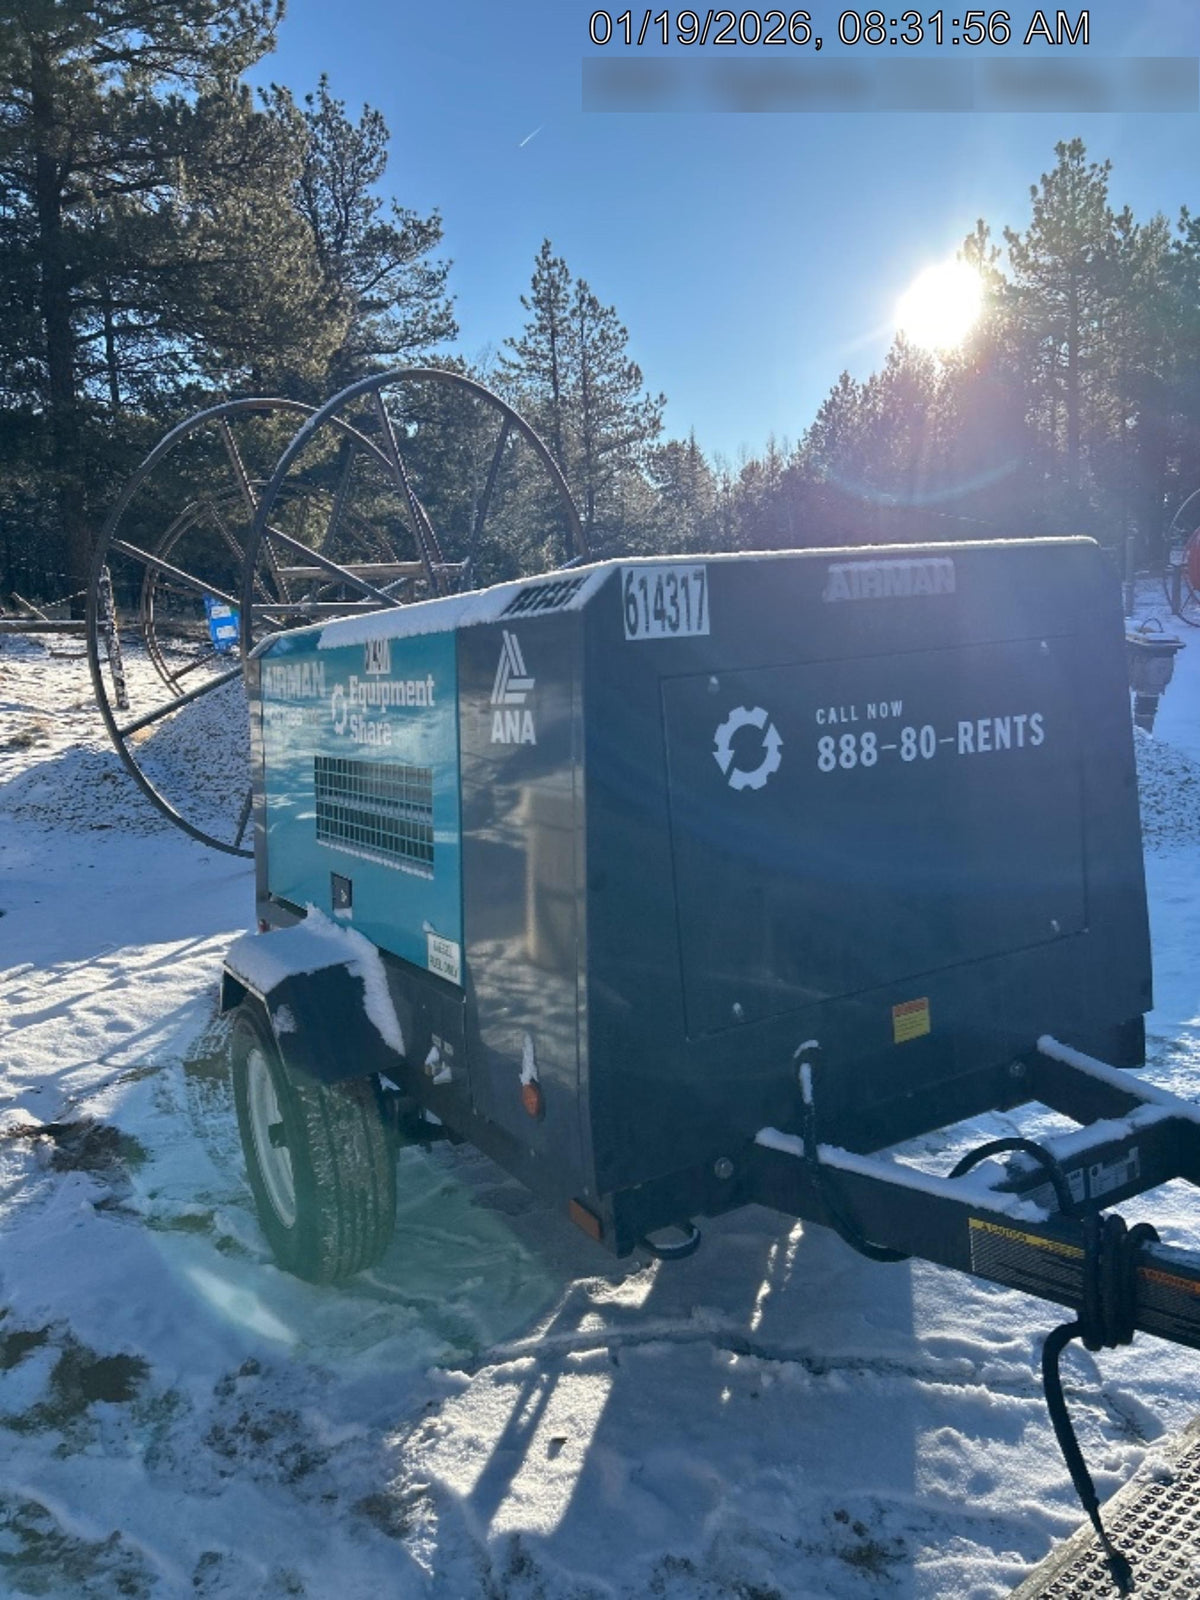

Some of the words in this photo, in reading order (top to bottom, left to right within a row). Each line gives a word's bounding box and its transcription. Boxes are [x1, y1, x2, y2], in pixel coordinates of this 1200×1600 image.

[823, 558, 955, 600] AIRMAN
[624, 569, 705, 637] 614317
[350, 674, 435, 713] Equipment
[816, 704, 858, 725] CALL
[867, 701, 903, 719] NOW
[350, 714, 392, 745] Share
[491, 710, 537, 745] ANA
[817, 713, 1045, 772] 888-80-RENTS
